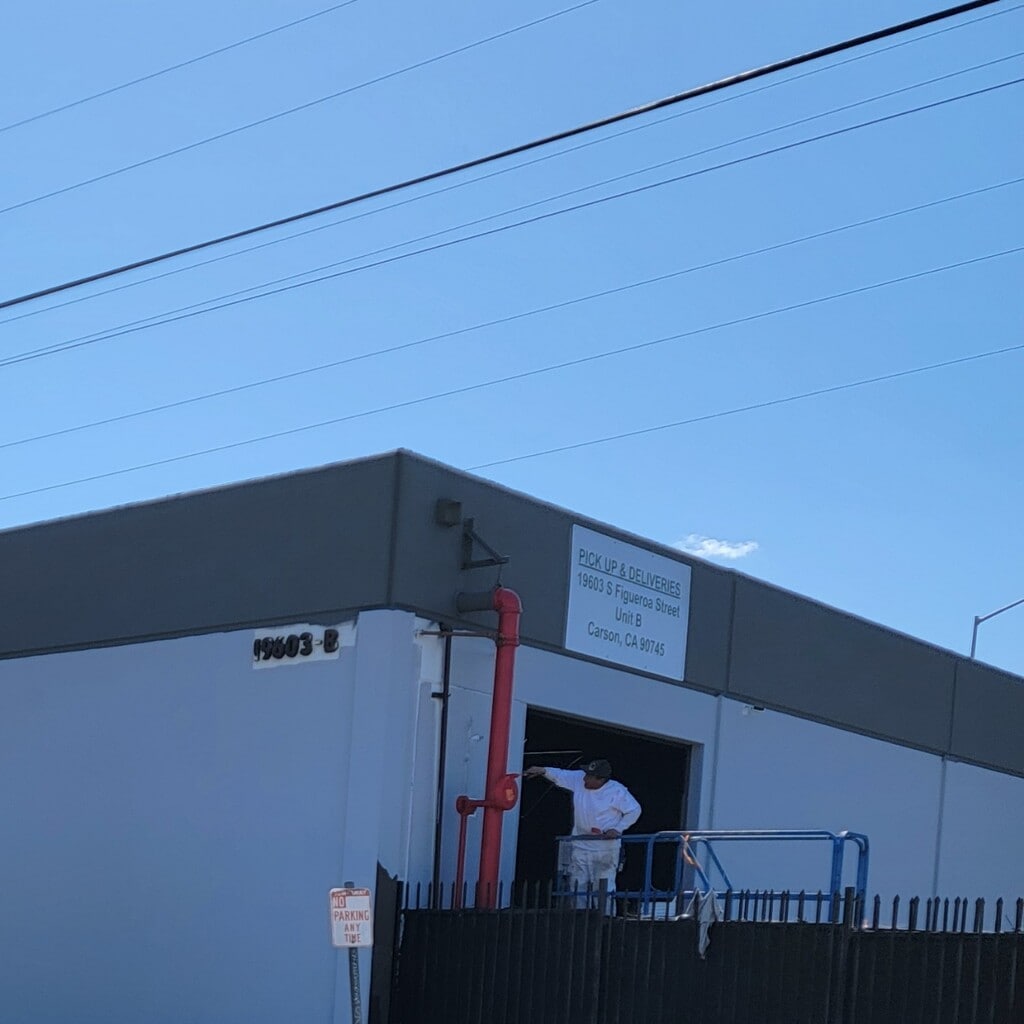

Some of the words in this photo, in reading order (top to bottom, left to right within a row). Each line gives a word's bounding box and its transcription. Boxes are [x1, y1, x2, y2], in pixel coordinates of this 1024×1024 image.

[579, 548, 602, 570] PICK
[605, 557, 618, 574] UP
[619, 563, 626, 577] &
[629, 566, 681, 596] DELIVERIES
[578, 572, 604, 593] 19603
[606, 581, 613, 596] S
[615, 584, 653, 609] Figueroa
[655, 597, 680, 618] Street
[615, 606, 634, 624] Unit
[635, 613, 642, 627] B
[587, 621, 623, 646] Carson,
[625, 632, 638, 649] CA
[639, 637, 665, 656] 90745
[332, 896, 345, 908] NO
[334, 910, 369, 921] PARKING
[344, 923, 360, 932] ANY
[344, 933, 361, 943] TIME
